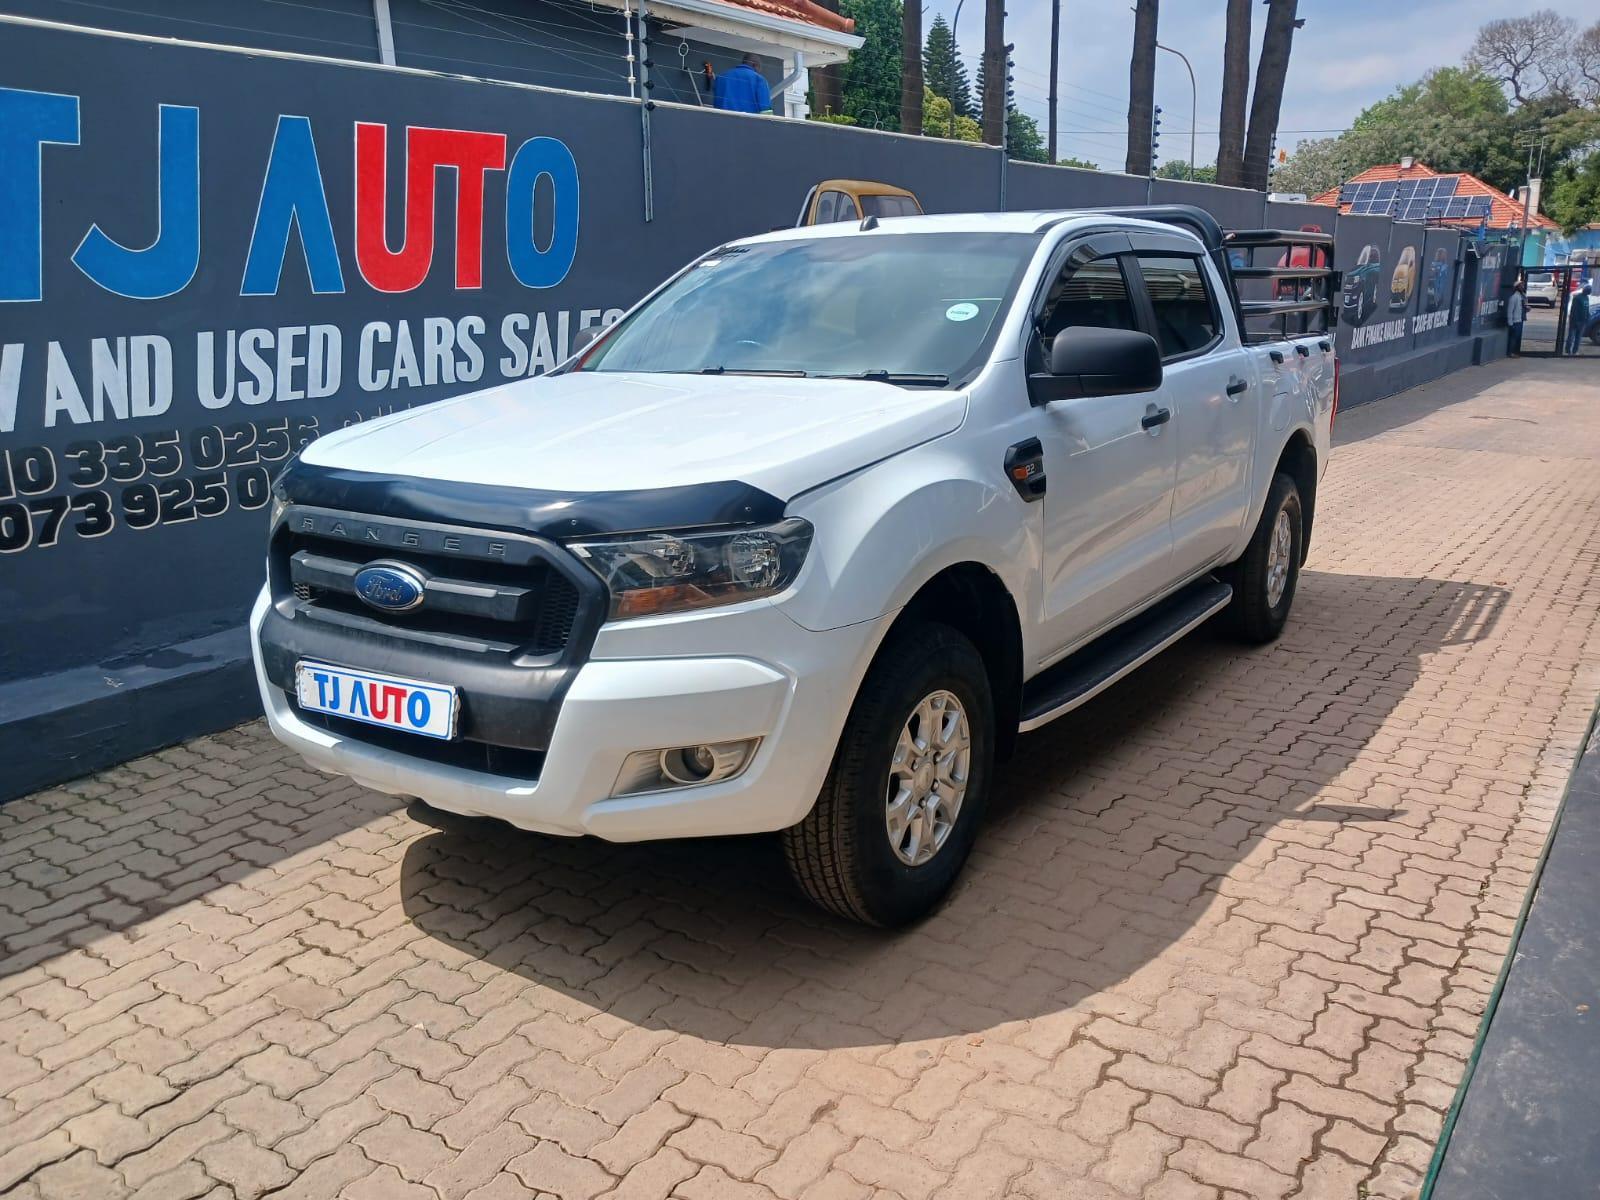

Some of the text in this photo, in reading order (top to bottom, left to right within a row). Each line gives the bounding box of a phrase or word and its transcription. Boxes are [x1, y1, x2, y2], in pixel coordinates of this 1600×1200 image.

[0, 88, 580, 301] TJ AUTO
[44, 335, 173, 428] AND
[197, 324, 342, 409] USED
[358, 315, 485, 392] CARS
[64, 430, 184, 487] 335
[0, 496, 114, 553] 073
[121, 471, 230, 530] 925
[301, 517, 507, 556] RANGER
[365, 574, 403, 601] Ford
[314, 672, 431, 728] TJ AUTO
